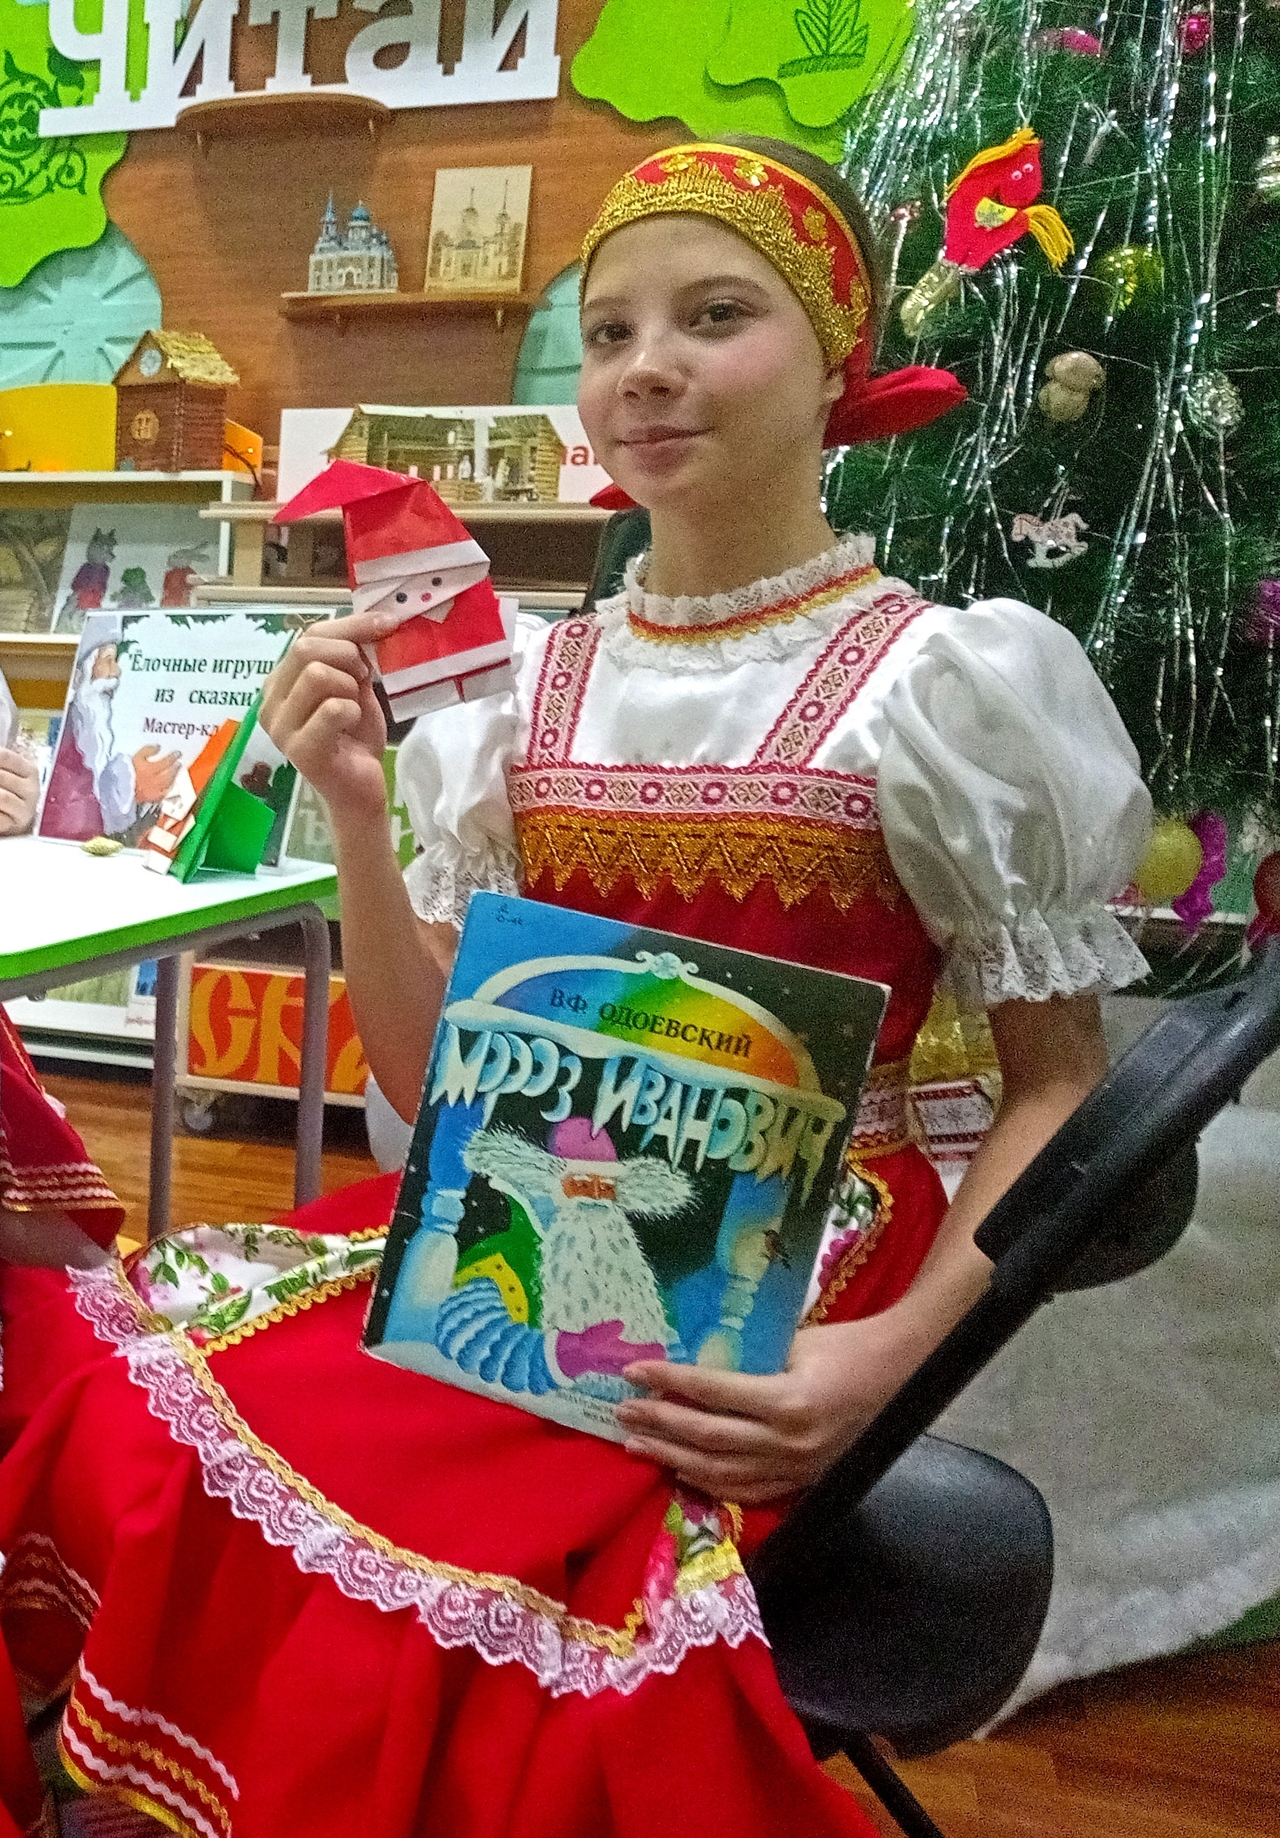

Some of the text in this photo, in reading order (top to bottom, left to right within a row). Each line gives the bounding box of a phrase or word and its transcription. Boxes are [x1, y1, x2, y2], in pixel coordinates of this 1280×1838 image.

[212, 659, 274, 679] игруш
[155, 688, 175, 703] из
[143, 717, 219, 739] Мастер-кл
[598, 1001, 753, 1059] ОДОЕВСКИЙ
[592, 1056, 837, 1208] ИВАНОВИЧ
